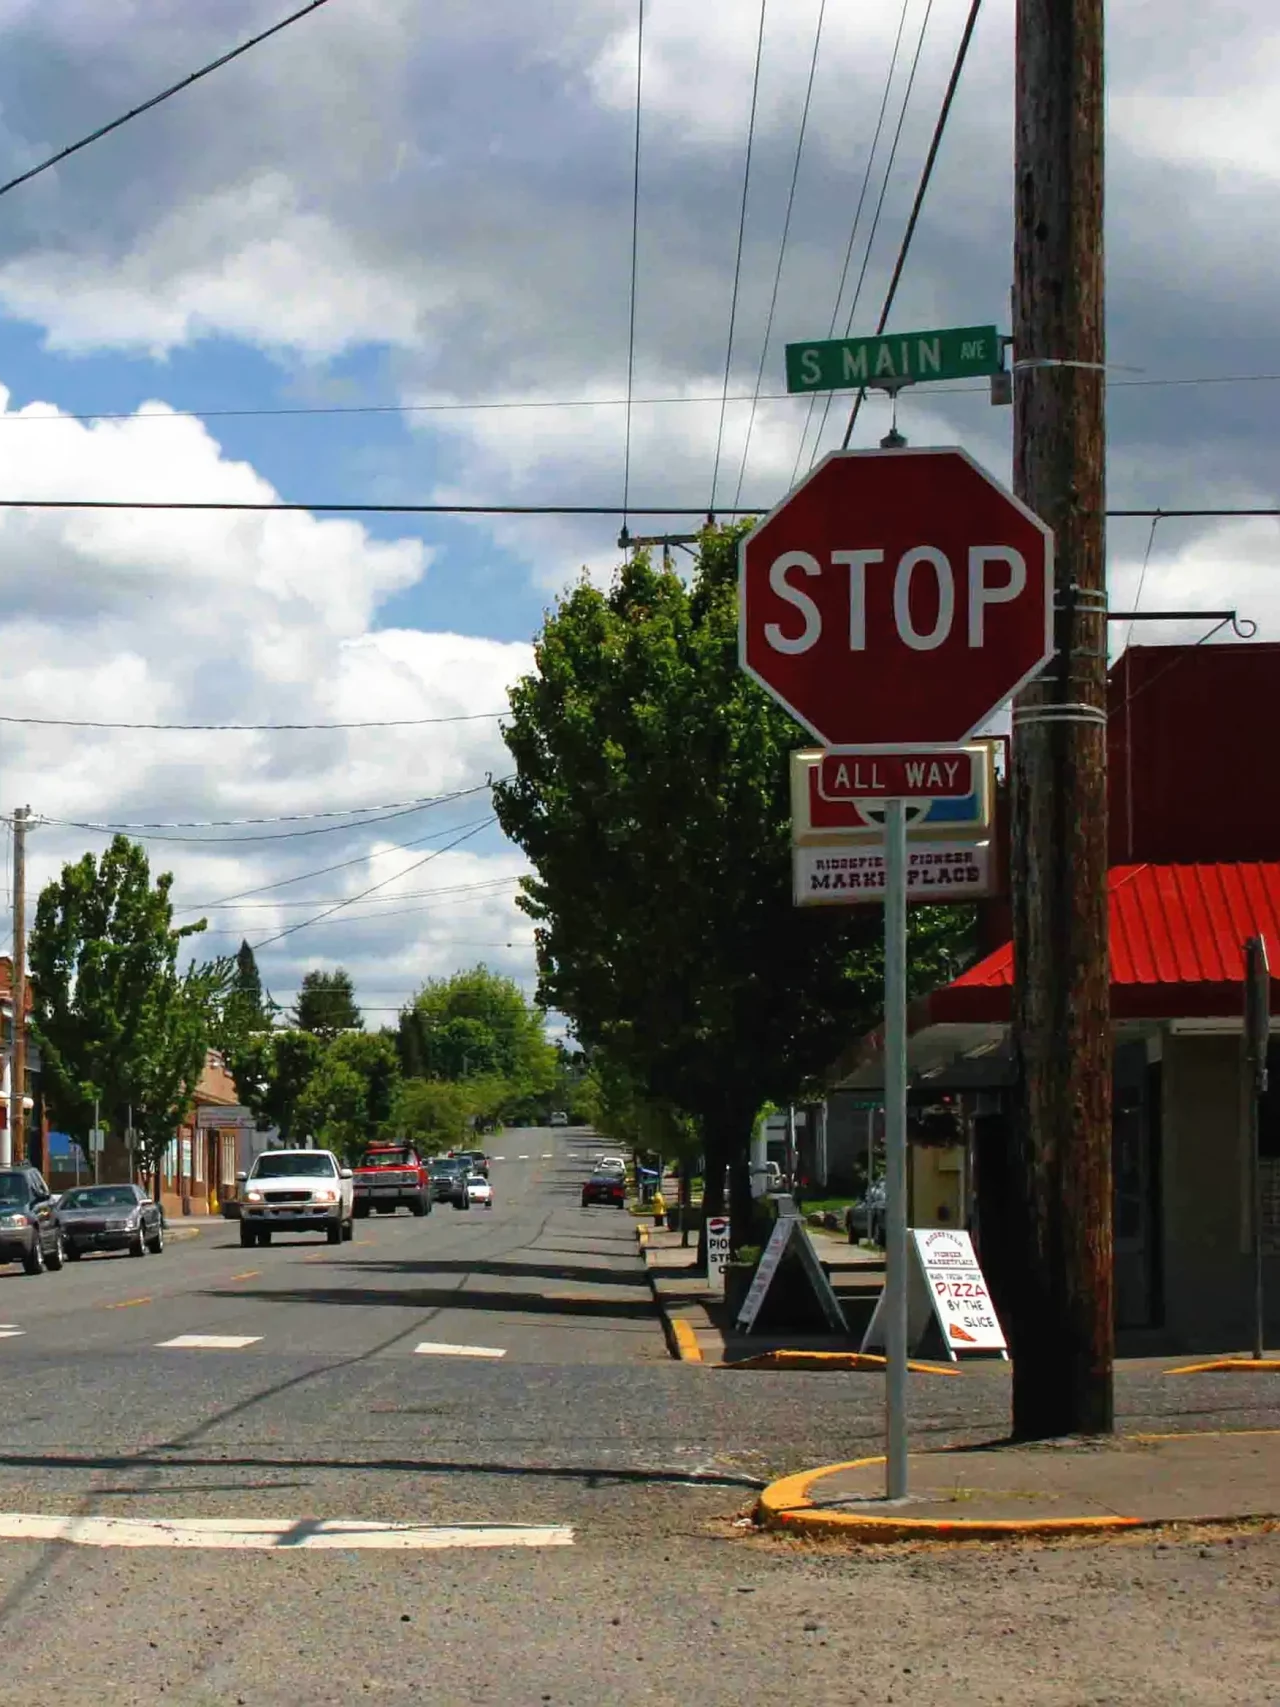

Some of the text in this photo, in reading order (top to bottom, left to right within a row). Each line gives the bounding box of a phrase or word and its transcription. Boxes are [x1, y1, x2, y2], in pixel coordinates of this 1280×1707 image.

[801, 338, 987, 385] S MAIN AVE
[763, 545, 1028, 655] STOP
[834, 761, 960, 789] ALL WAY
[816, 851, 974, 871] RIDGEFIE PIONEER
[709, 1239, 731, 1249] PIO
[710, 1253, 731, 1263] STR
[935, 1282, 987, 1298] PIZZA
[947, 1299, 984, 1311] BY THE
[963, 1316, 995, 1328] SLICE
